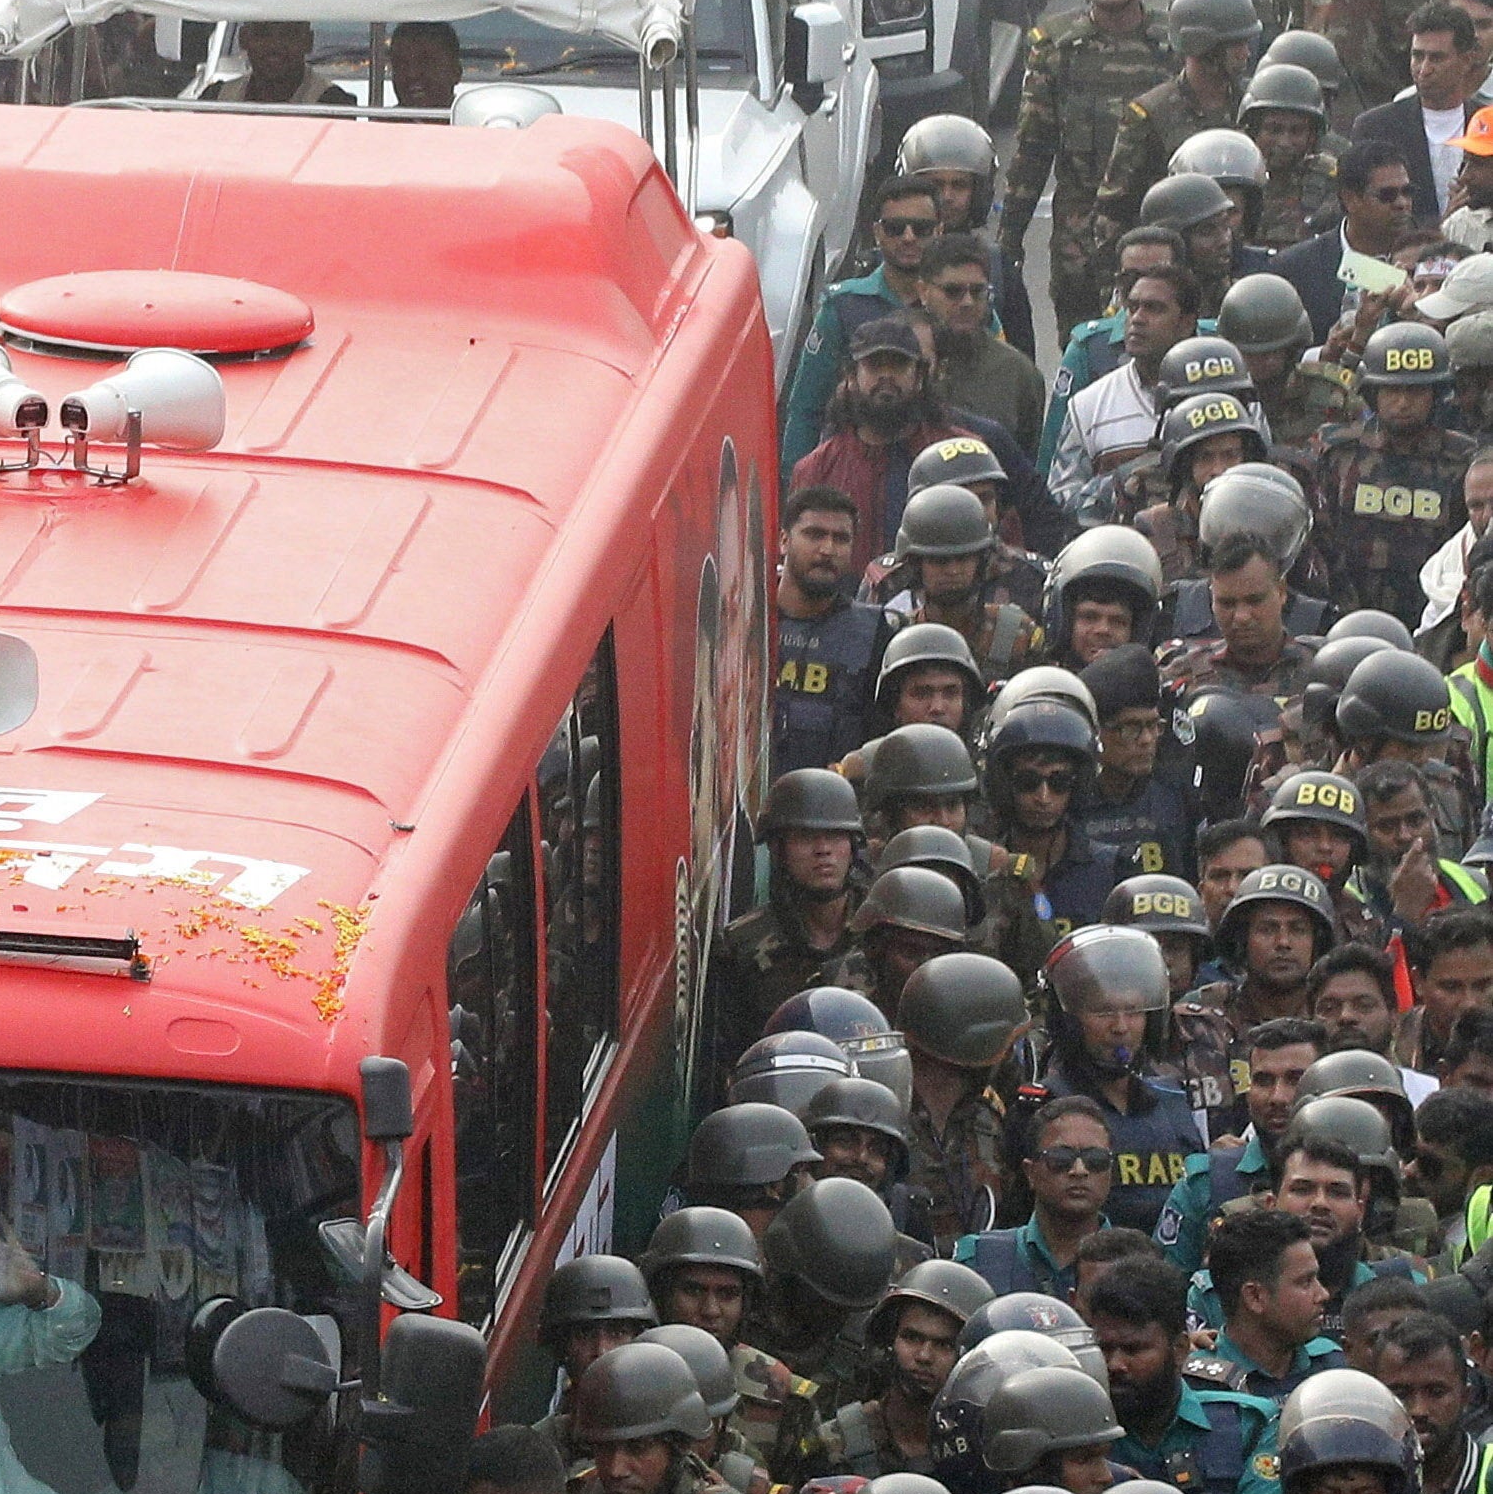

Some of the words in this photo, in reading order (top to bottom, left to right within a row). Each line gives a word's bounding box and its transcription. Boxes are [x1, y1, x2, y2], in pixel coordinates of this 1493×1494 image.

[1185, 357, 1235, 384] BGB
[1384, 348, 1434, 372] BGB
[1187, 400, 1238, 429] BGB
[1354, 482, 1440, 520] BGB
[775, 659, 828, 694] AB
[1414, 707, 1451, 732] BG
[1295, 782, 1355, 815] BGB
[1133, 893, 1191, 918] BGB
